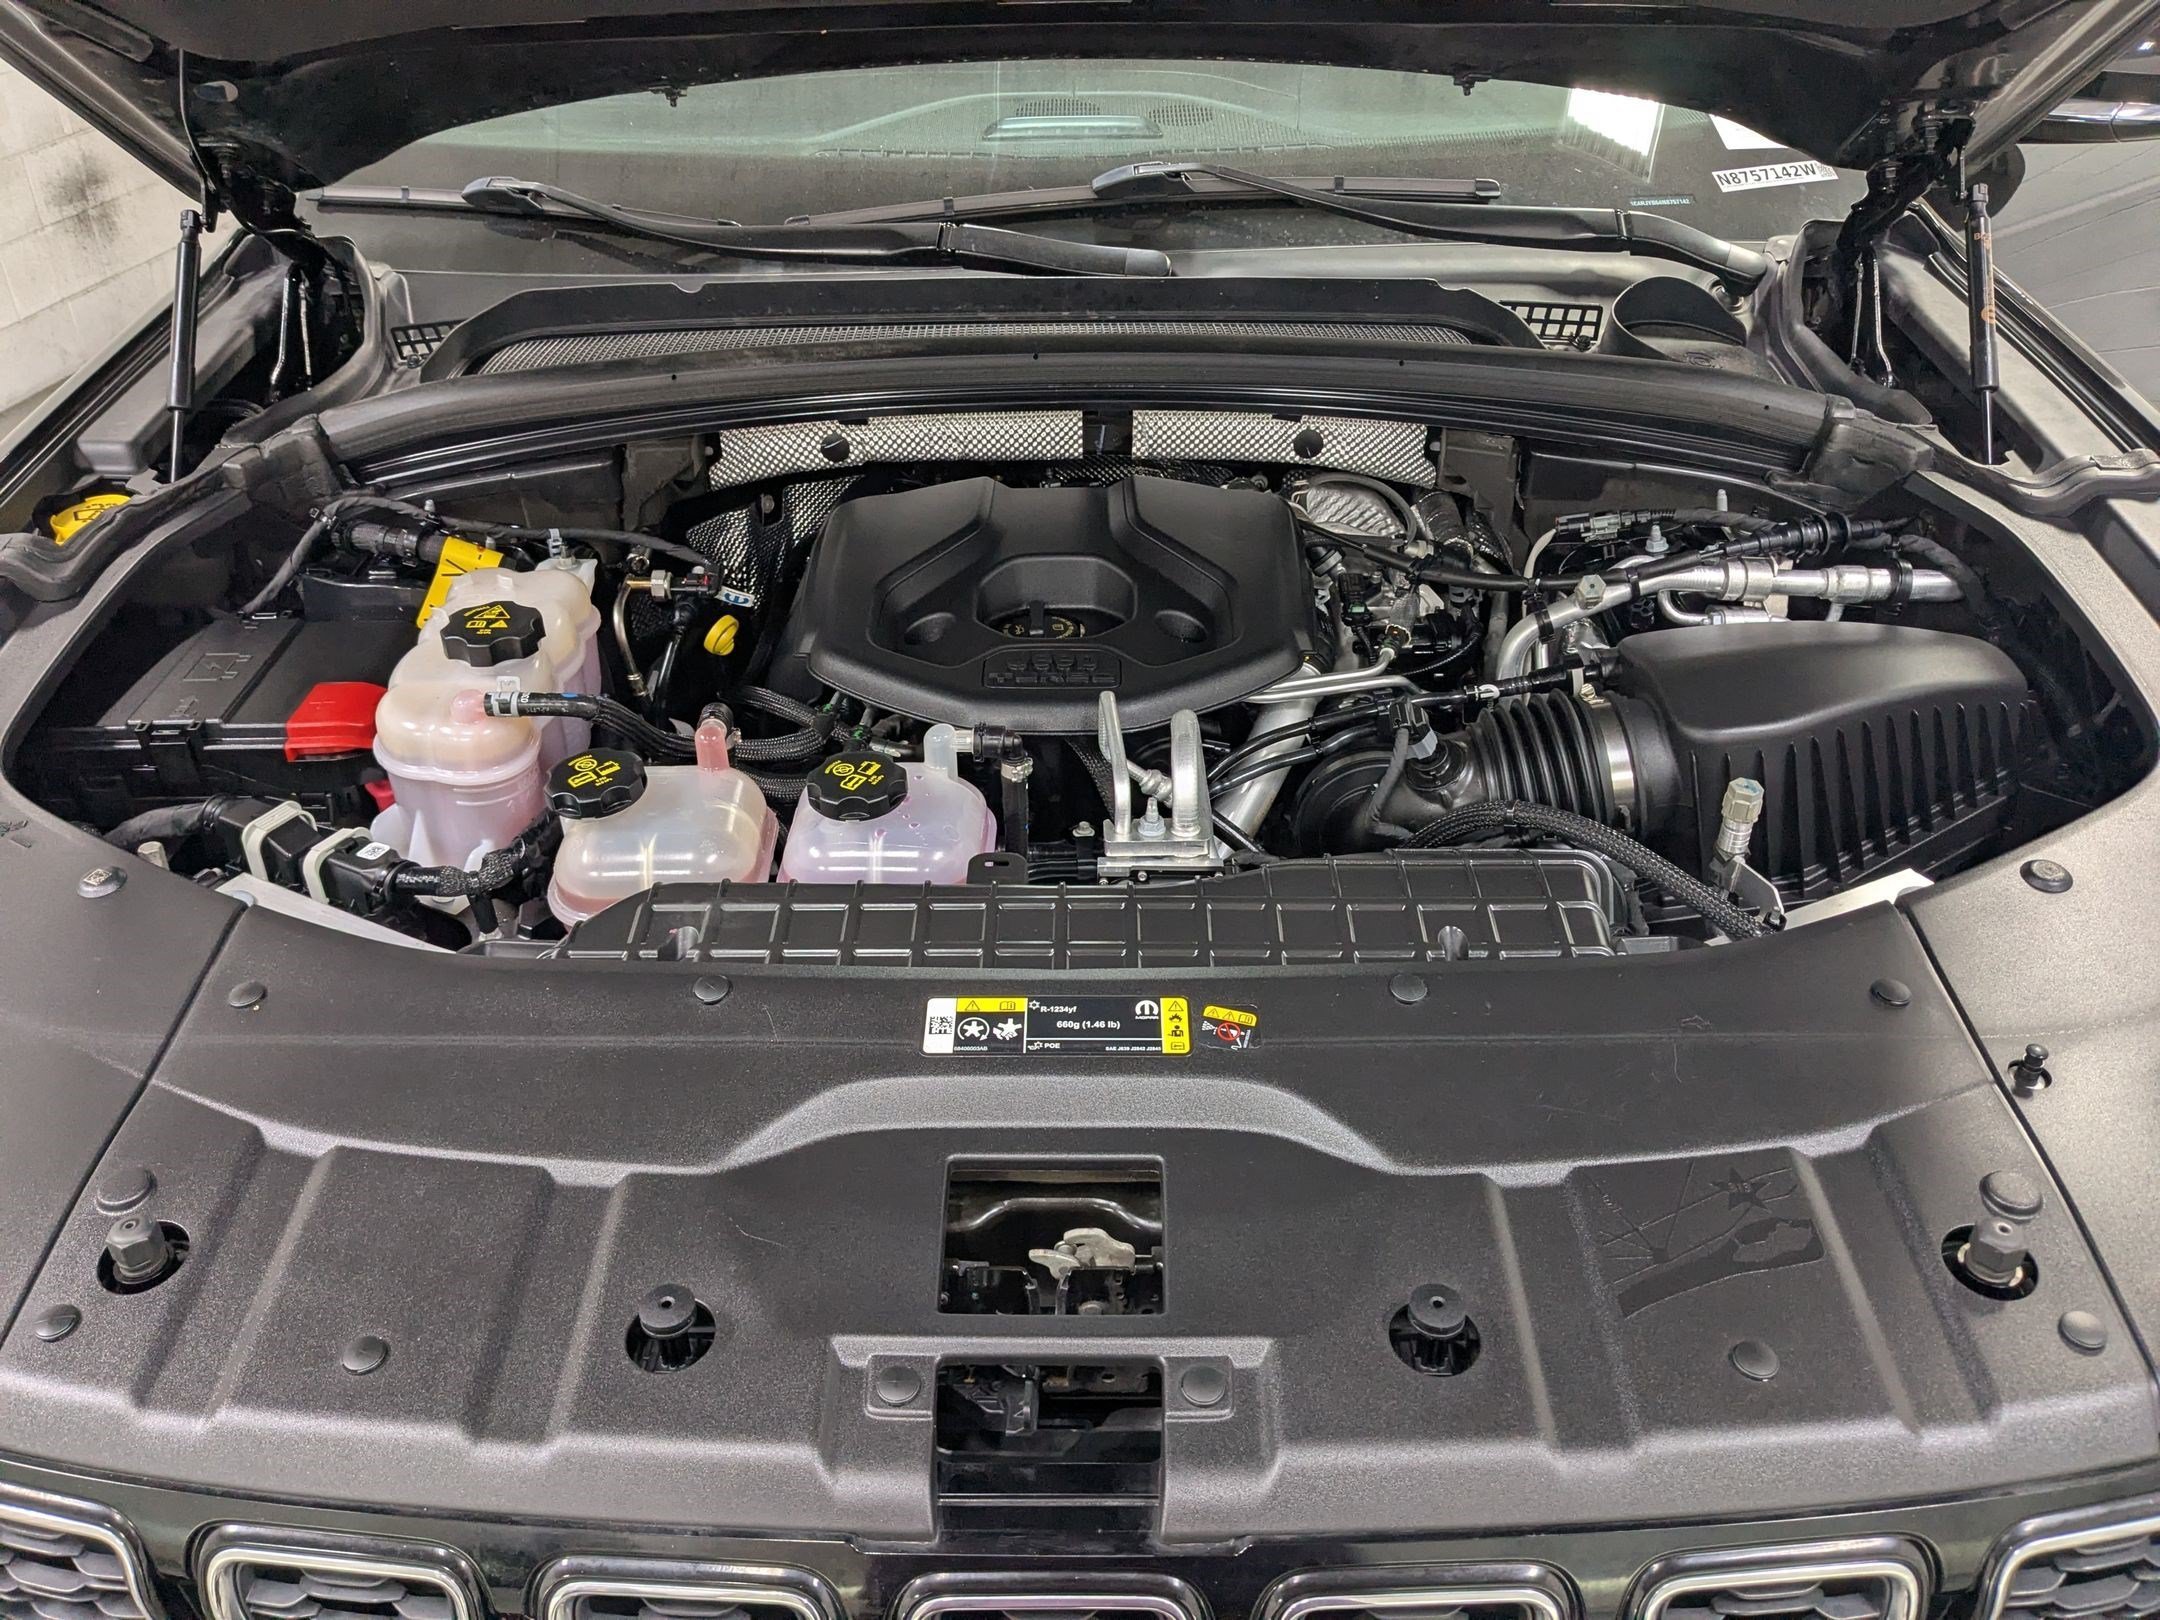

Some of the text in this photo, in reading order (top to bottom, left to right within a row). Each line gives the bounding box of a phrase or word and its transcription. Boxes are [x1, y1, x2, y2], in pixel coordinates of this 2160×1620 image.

[1716, 163, 1817, 186] N8757142W
[1040, 1005, 1077, 1015] R-1234yf
[1056, 1019, 1121, 1031] 660g (1.46 lb)
